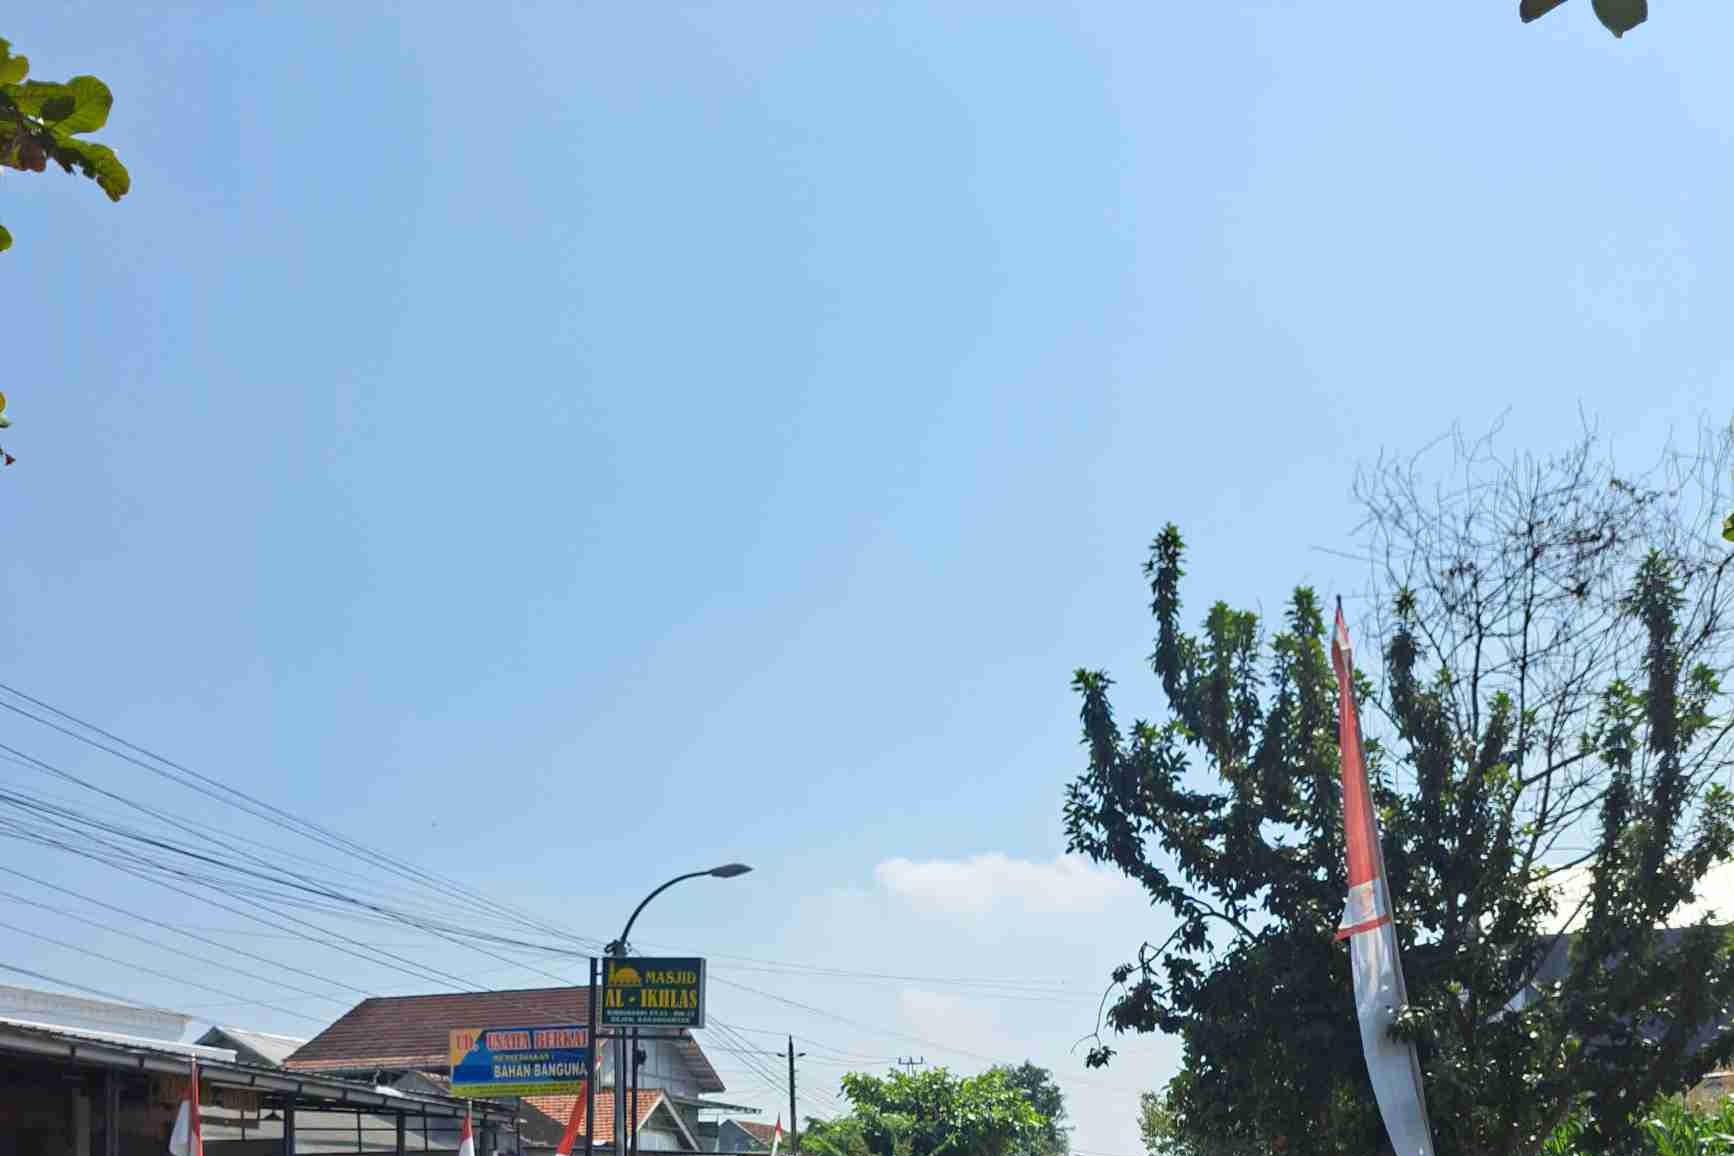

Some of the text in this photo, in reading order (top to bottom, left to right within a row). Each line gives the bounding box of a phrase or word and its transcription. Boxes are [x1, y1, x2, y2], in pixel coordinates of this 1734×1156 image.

[645, 970, 696, 984] MASJID
[606, 989, 624, 1008] AL
[640, 989, 697, 1008] IKHLAS
[494, 1062, 588, 1078] BAHAN BANGUNA
